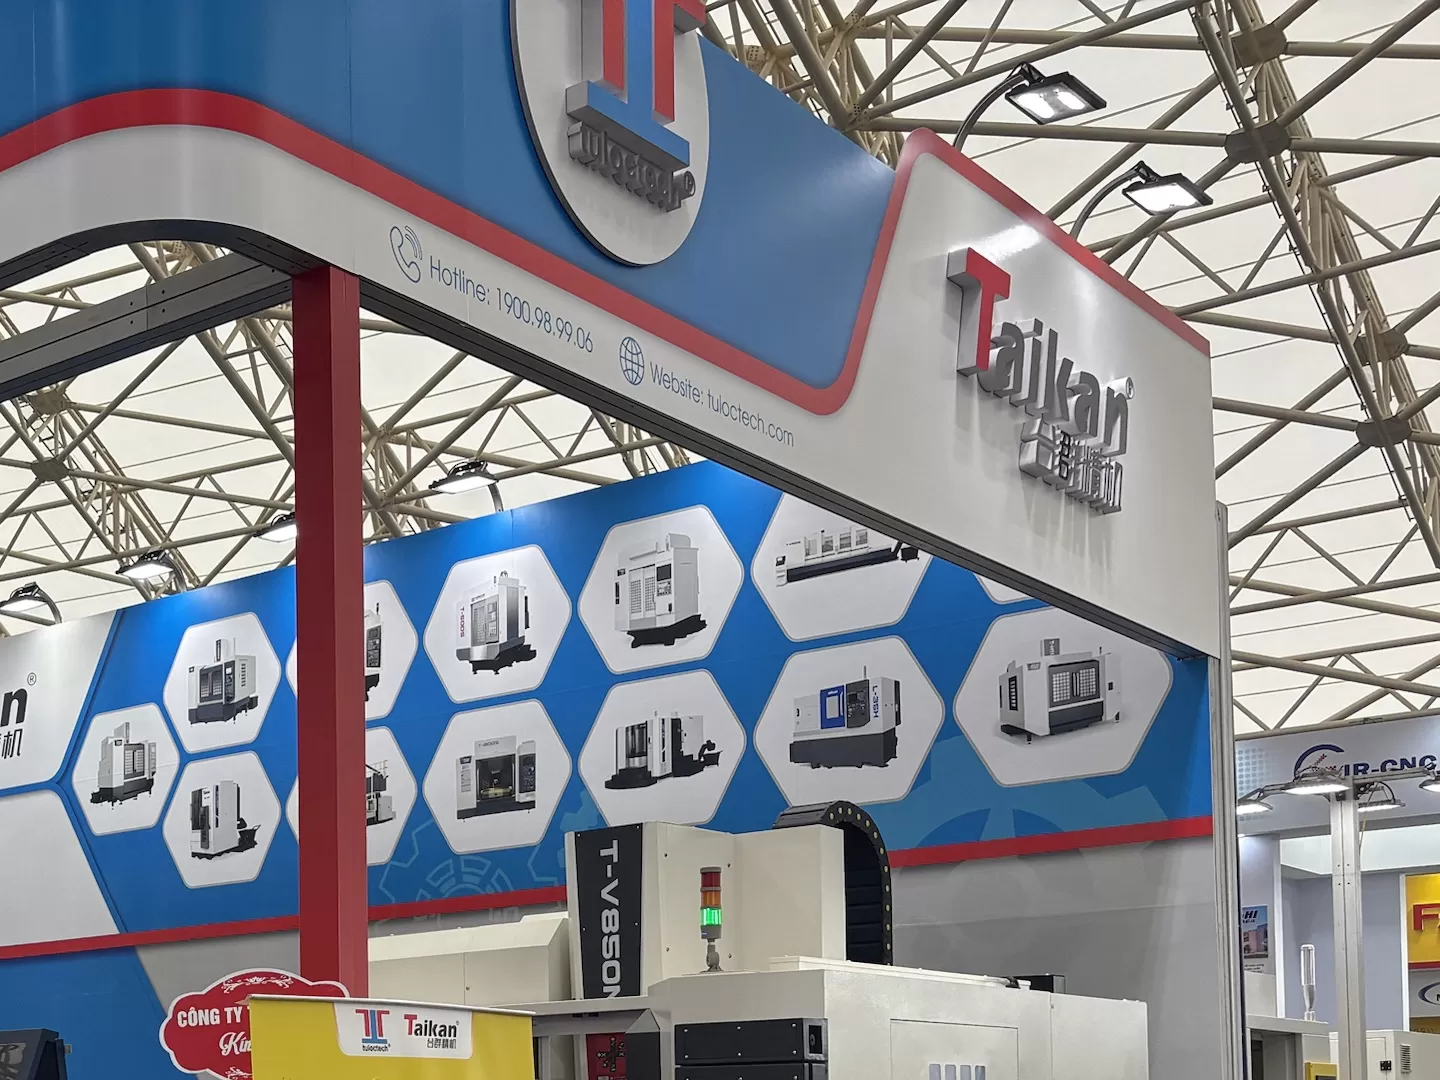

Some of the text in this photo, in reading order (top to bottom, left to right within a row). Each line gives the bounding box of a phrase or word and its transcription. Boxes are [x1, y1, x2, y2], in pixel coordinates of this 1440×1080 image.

[430, 255, 794, 448] Hotline: 1900.98.99.06 Website: tuloctech.com
[177, 1005, 241, 1028] CÔNG TY
[426, 1037, 457, 1050] 台群精机
